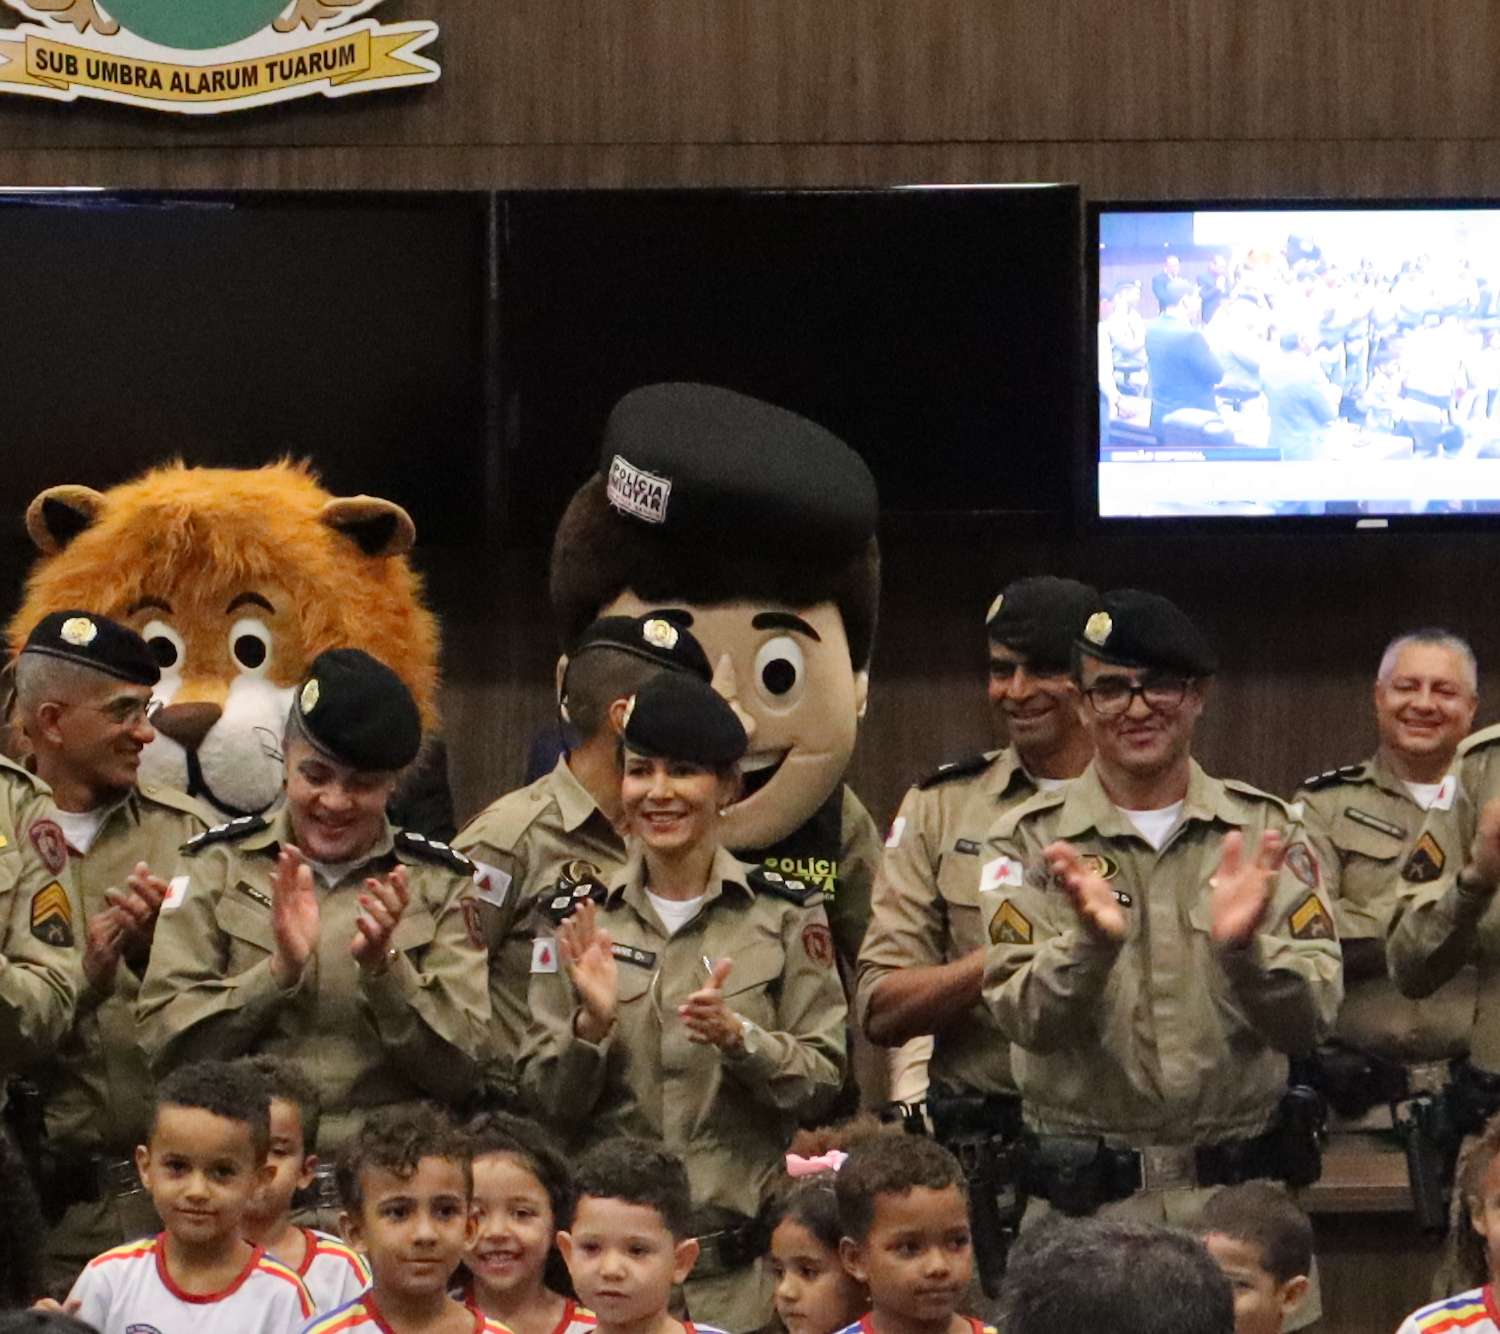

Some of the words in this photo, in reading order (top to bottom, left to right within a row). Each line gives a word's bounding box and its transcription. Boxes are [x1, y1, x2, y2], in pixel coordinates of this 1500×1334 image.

[34, 47, 79, 76] SUB
[86, 58, 164, 91] UMBRA
[169, 65, 260, 95] ALARUM
[265, 43, 357, 83] TUARUM
